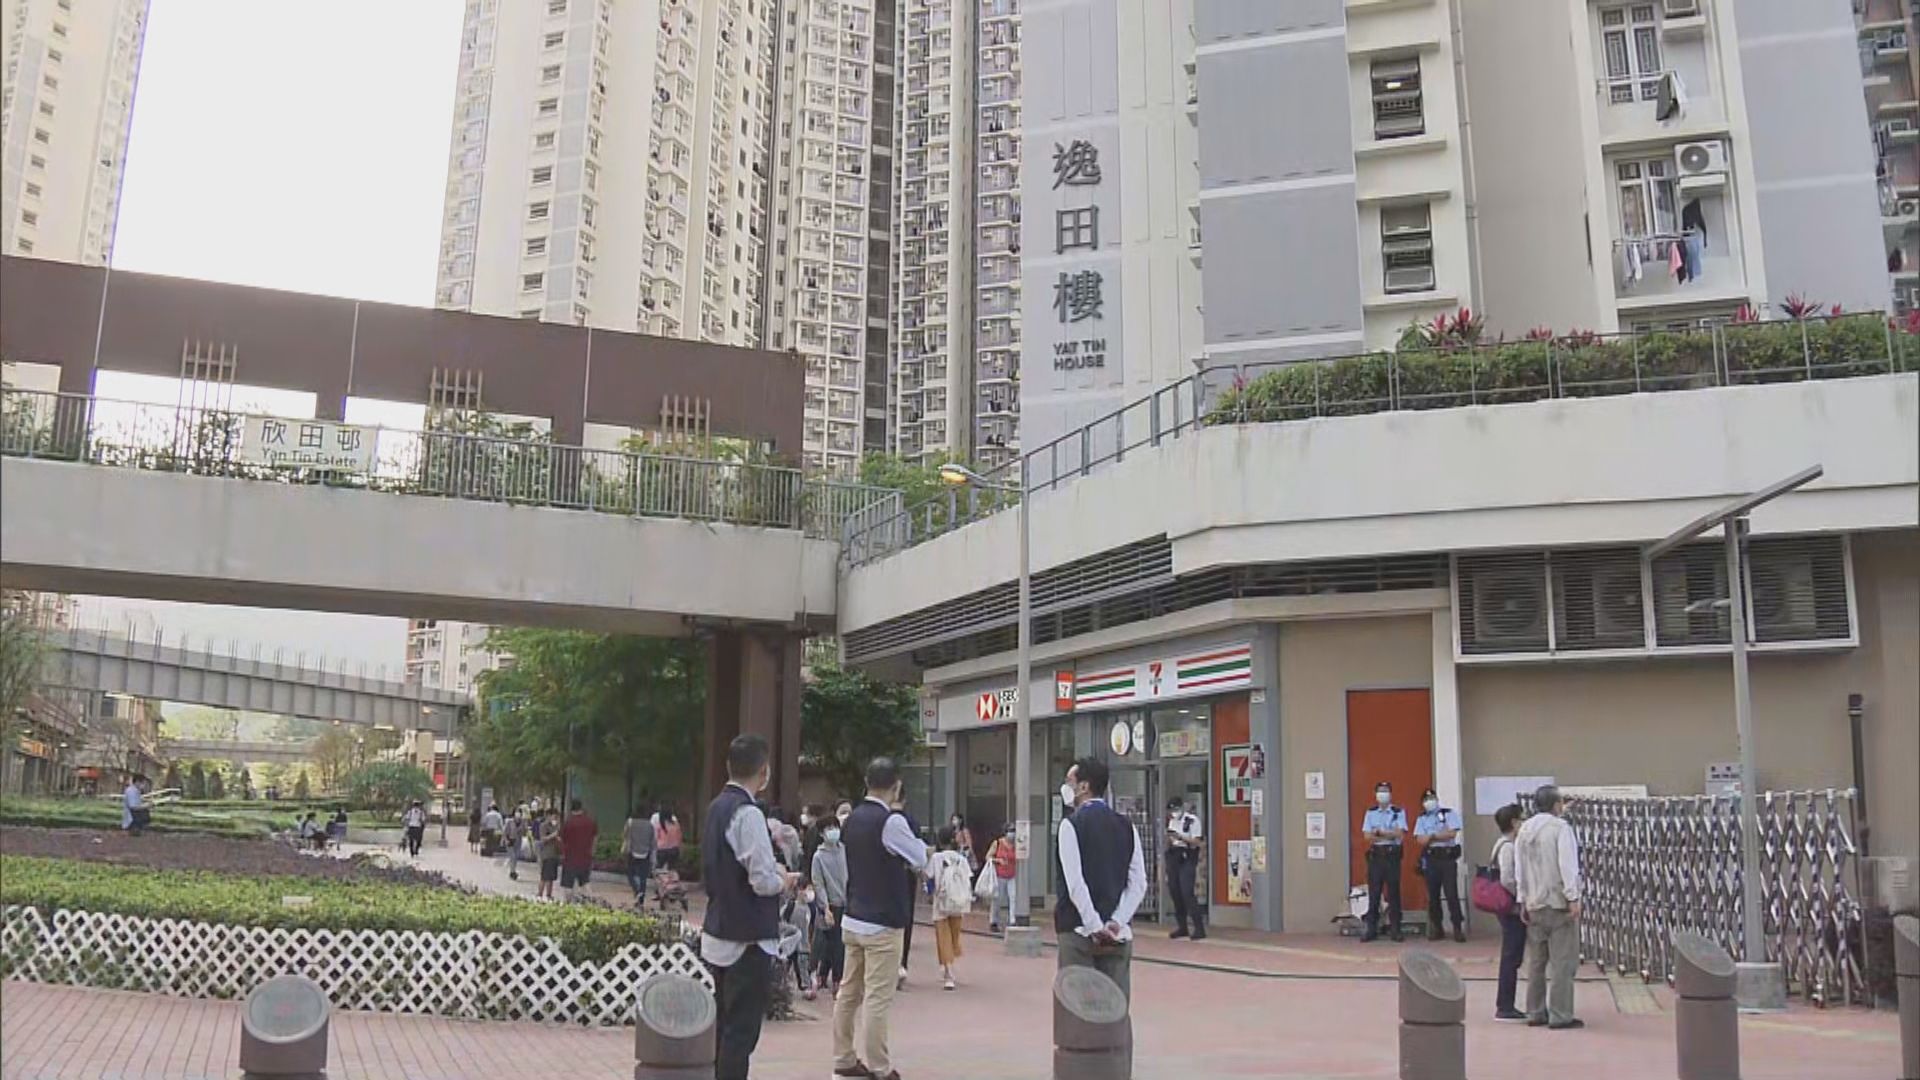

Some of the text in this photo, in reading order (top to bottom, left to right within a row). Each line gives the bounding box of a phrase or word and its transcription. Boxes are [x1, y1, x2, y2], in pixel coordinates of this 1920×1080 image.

[1052, 140, 1103, 323] 逸田樓
[1053, 338, 1106, 356] YAT TIN
[1053, 354, 1105, 371] HOUSE
[261, 420, 360, 451] 欣田邨
[292, 449, 312, 463] Tin
[316, 452, 357, 467] Estate
[1149, 662, 1162, 695] 7
[1230, 756, 1249, 801] 7
